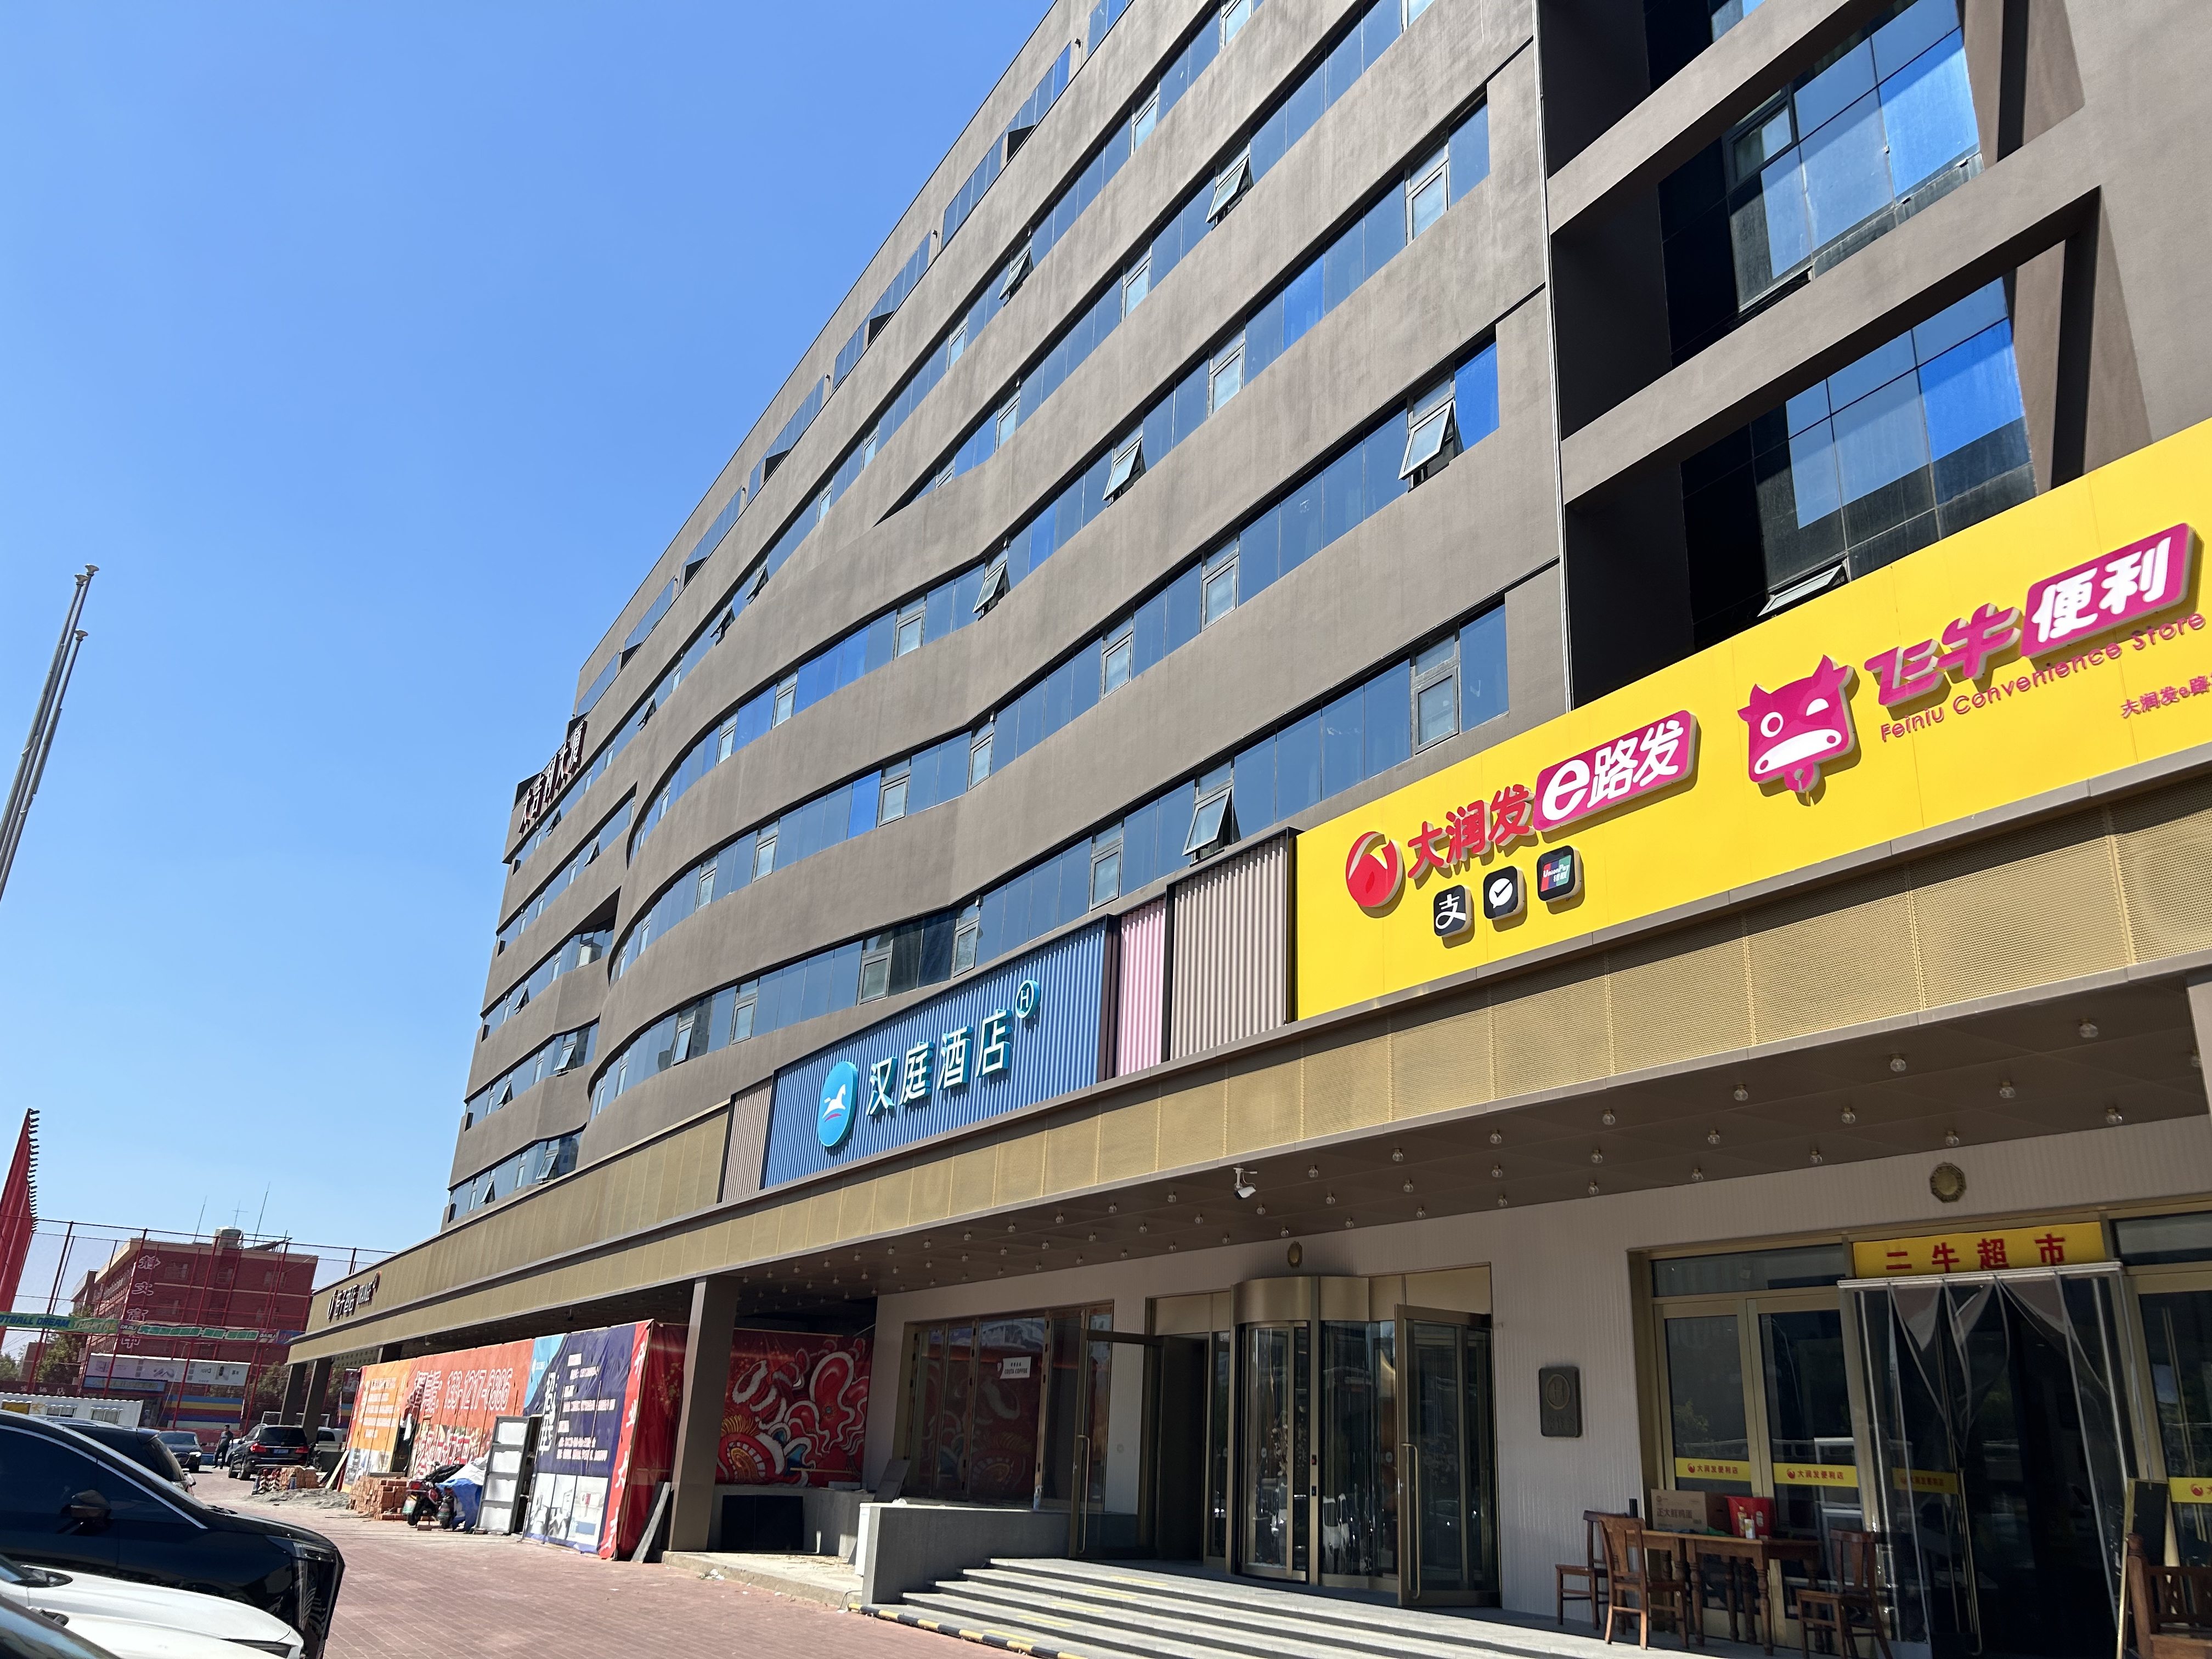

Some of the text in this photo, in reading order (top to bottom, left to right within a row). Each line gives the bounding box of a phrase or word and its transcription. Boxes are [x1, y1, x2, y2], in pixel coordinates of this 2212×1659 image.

[1865, 537, 2171, 707] 飞牛 便利
[1880, 613, 2206, 742] Feiniu Convenience Store
[2120, 675, 2212, 719] 大润发e路
[518, 720, 584, 833] 大吉利大厦
[1408, 720, 1684, 879] 大润发 e路发
[866, 1008, 1013, 1116] 汉庭酒店
[1886, 1233, 2066, 1274] 二牛超市
[36, 1317, 71, 1328] DREAM
[1696, 1464, 1739, 1475] 大润发便利店
[1797, 1469, 1844, 1481] 大润发便利店
